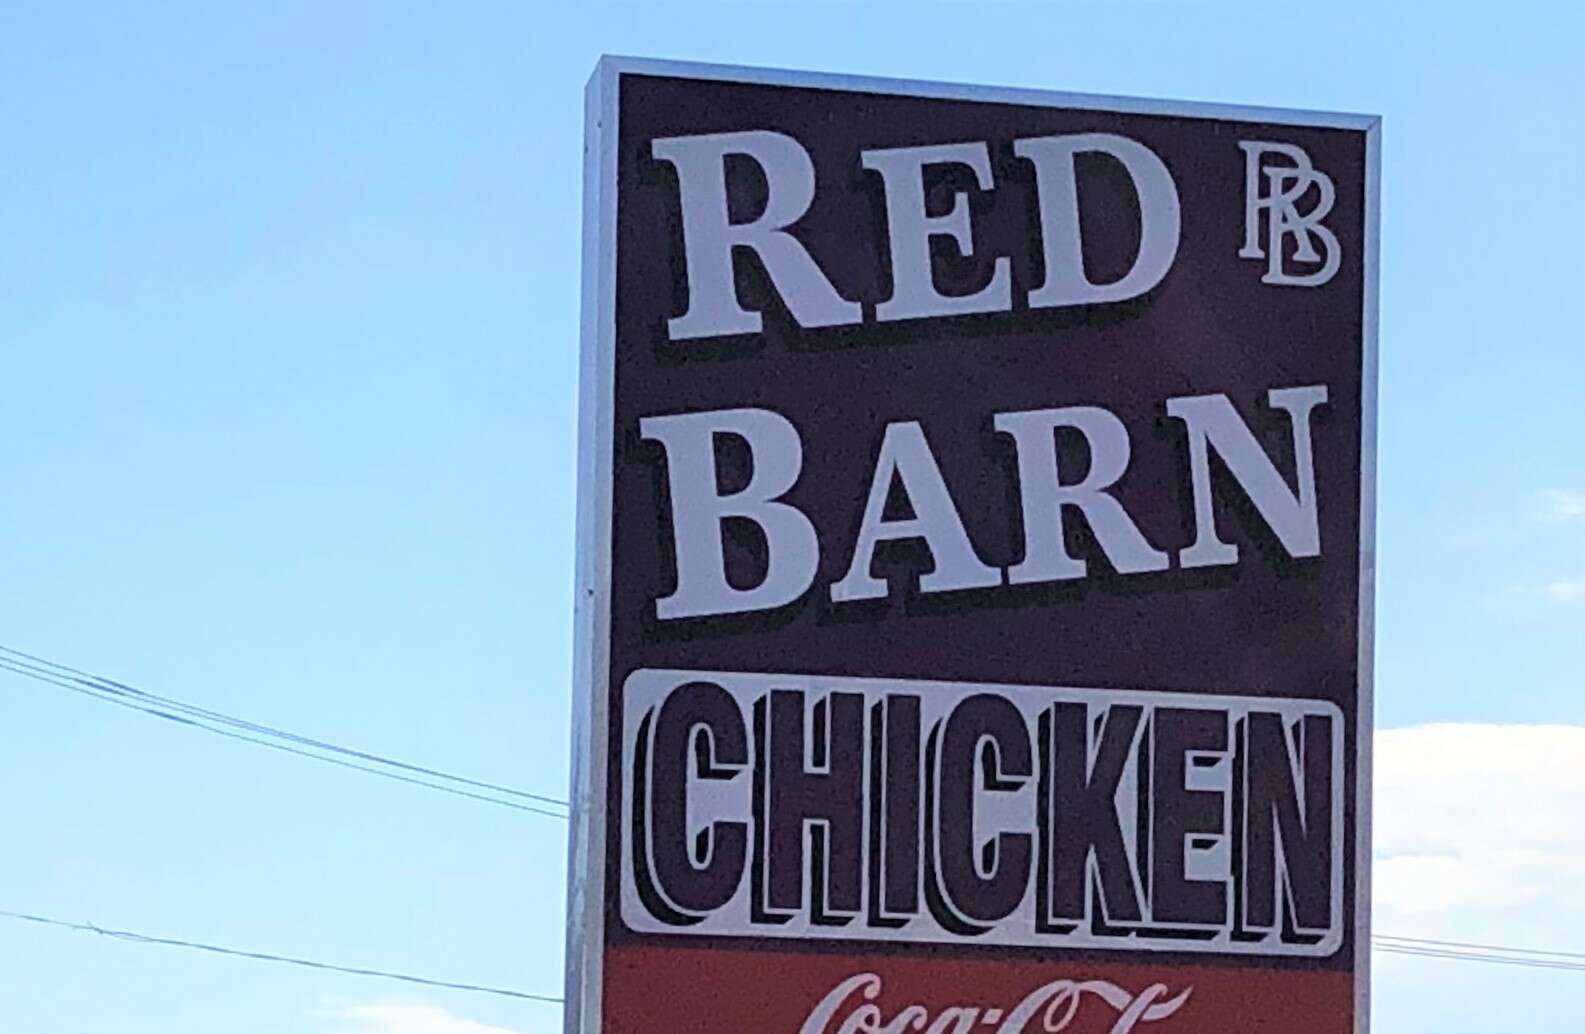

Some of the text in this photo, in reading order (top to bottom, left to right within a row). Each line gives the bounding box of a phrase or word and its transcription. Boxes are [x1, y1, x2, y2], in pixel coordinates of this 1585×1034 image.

[651, 130, 1181, 341] RED
[639, 385, 1329, 621] BARN
[632, 682, 1333, 945] CHICKEN
